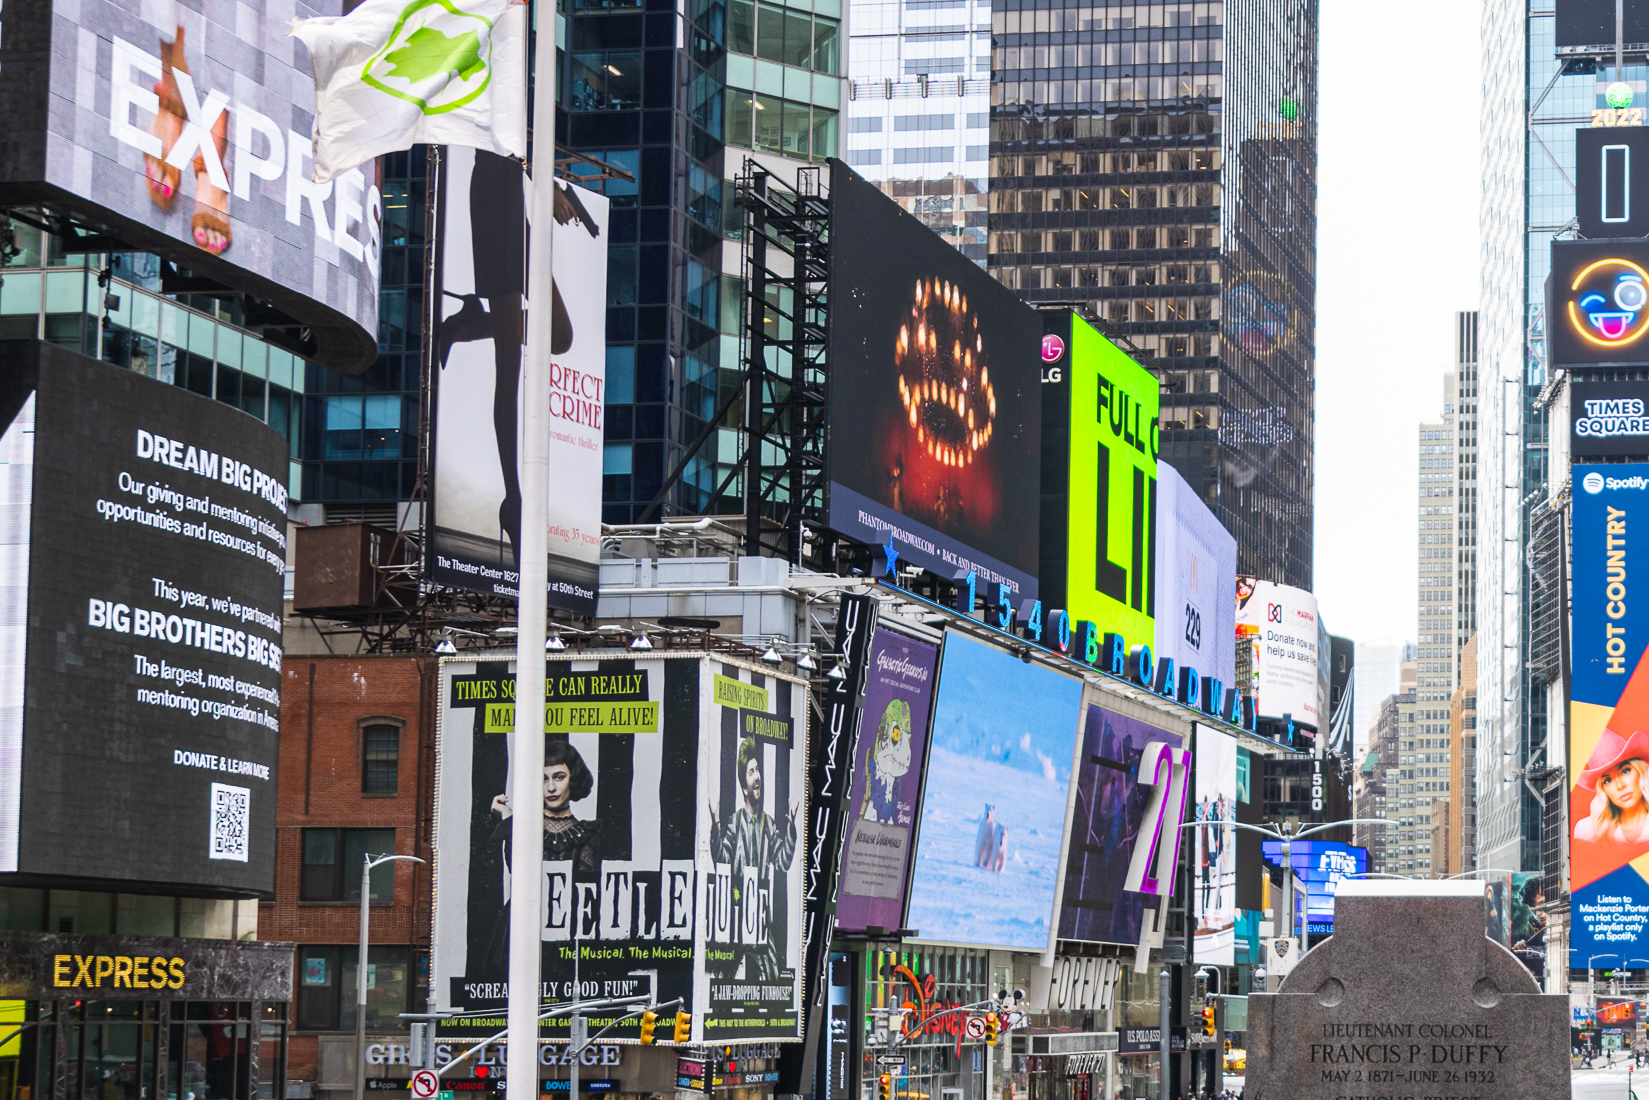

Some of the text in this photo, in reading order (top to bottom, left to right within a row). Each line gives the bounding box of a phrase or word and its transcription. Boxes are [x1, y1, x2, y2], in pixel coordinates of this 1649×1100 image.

[1591, 108, 1642, 127] 2022
[1097, 372, 1144, 453] FULL
[1585, 400, 1644, 416] TIMES
[136, 428, 251, 492] DREAM BIG
[1606, 476, 1648, 490] Spotify
[118, 471, 209, 515] Our giving and
[96, 498, 207, 541] opportunities and
[942, 548, 957, 566] BACK
[437, 555, 503, 581] The Theater Center
[152, 577, 179, 602] This
[560, 582, 574, 595] 50th
[574, 586, 594, 600] Street
[1607, 505, 1625, 674] HOT COUNTRY
[88, 598, 268, 666] BIG BROTHERS BIG
[1185, 603, 1201, 650] 229
[1267, 630, 1295, 646] Donate
[1267, 645, 1295, 660] help us
[134, 654, 159, 678] The
[1085, 620, 1257, 731] BROADWAY
[456, 674, 643, 700] TIMES CAN REALLY
[718, 681, 765, 711] RAISING SPIRITS
[136, 687, 199, 716] mentoring
[569, 707, 654, 726] FEEL ALIVE!
[745, 714, 789, 741] ON BROADWAY!
[173, 749, 218, 770] DONATE
[1312, 760, 1323, 811] 1500
[1579, 904, 1623, 912] Mackenzie
[1597, 895, 1632, 903] Listen to
[1595, 923, 1643, 932] playlist only
[1613, 914, 1647, 923] Country,
[1607, 932, 1637, 942] Spotify.
[559, 946, 649, 960] The The
[53, 954, 186, 990] EXPRESS
[1048, 956, 1121, 1009] FOREVER
[1136, 1030, 1149, 1042] POLO
[1323, 1024, 1492, 1038] LIEUTENANT COLONEL
[1310, 1044, 1508, 1063] FRANCIS DUFFY
[1066, 1055, 1097, 1075] FOREVER
[378, 1081, 397, 1090] Apple
[446, 1081, 485, 1090] Canon
[745, 1074, 763, 1083] SONY
